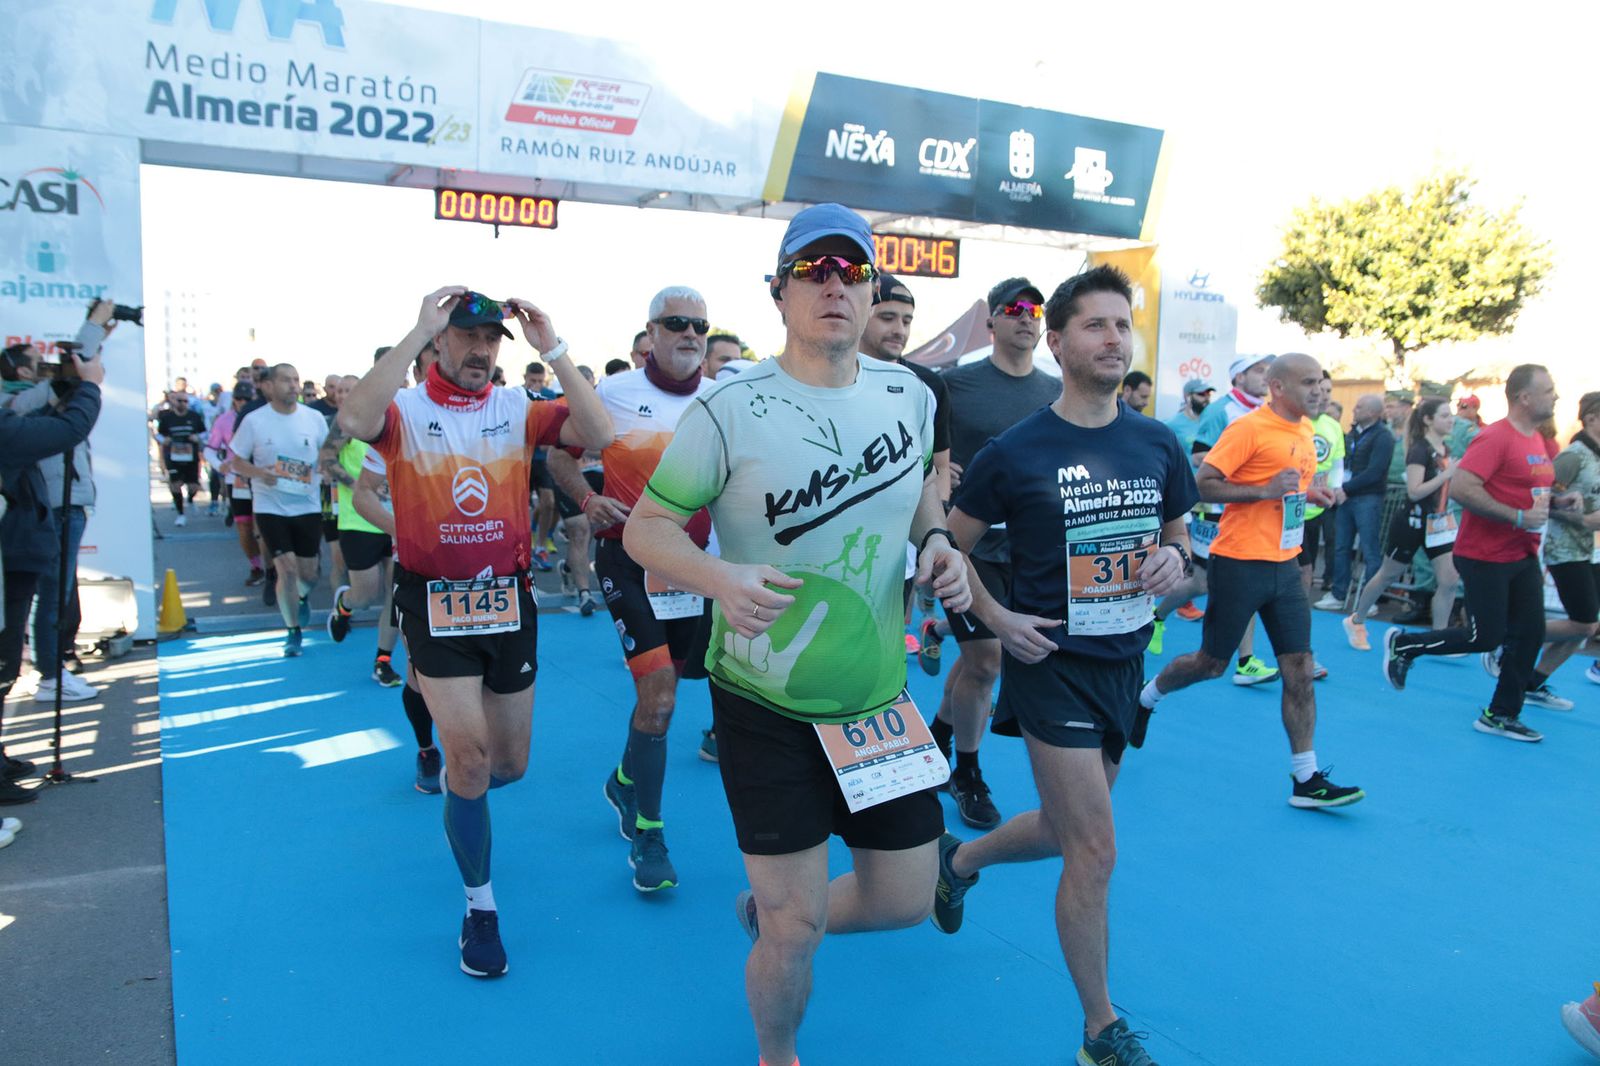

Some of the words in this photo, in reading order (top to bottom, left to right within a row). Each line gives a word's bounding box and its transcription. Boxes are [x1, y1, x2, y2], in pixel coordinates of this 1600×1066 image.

[145, 40, 267, 84] Medio
[287, 59, 438, 105] Maratón
[144, 79, 319, 133] Almería
[533, 110, 577, 126] Prueba
[578, 116, 616, 130] Oficial
[500, 136, 580, 160] RAMÓN
[589, 145, 637, 166] RUIZ
[644, 152, 738, 177] ANDÚJAR
[918, 137, 977, 172] CDX
[0, 274, 108, 304] ajamar
[1060, 481, 1103, 499] Medio
[1106, 475, 1157, 492] Maratón
[1063, 491, 1122, 515] Almería
[439, 519, 505, 533] CITROËN
[1064, 513, 1097, 528] RAMÓN
[1098, 510, 1119, 521] RUIZ
[1121, 505, 1157, 518] ANDÚJA
[439, 533, 484, 545] SALINAS
[485, 530, 505, 543] CAR
[1092, 550, 1149, 585] 317
[1082, 583, 1122, 594] JOAQUIN
[440, 589, 510, 616] 1145
[451, 615, 472, 623] PACO
[473, 613, 498, 622] BUENO
[841, 706, 907, 749] 610
[853, 744, 883, 759] ANGEL
[883, 736, 911, 751] PABLO
